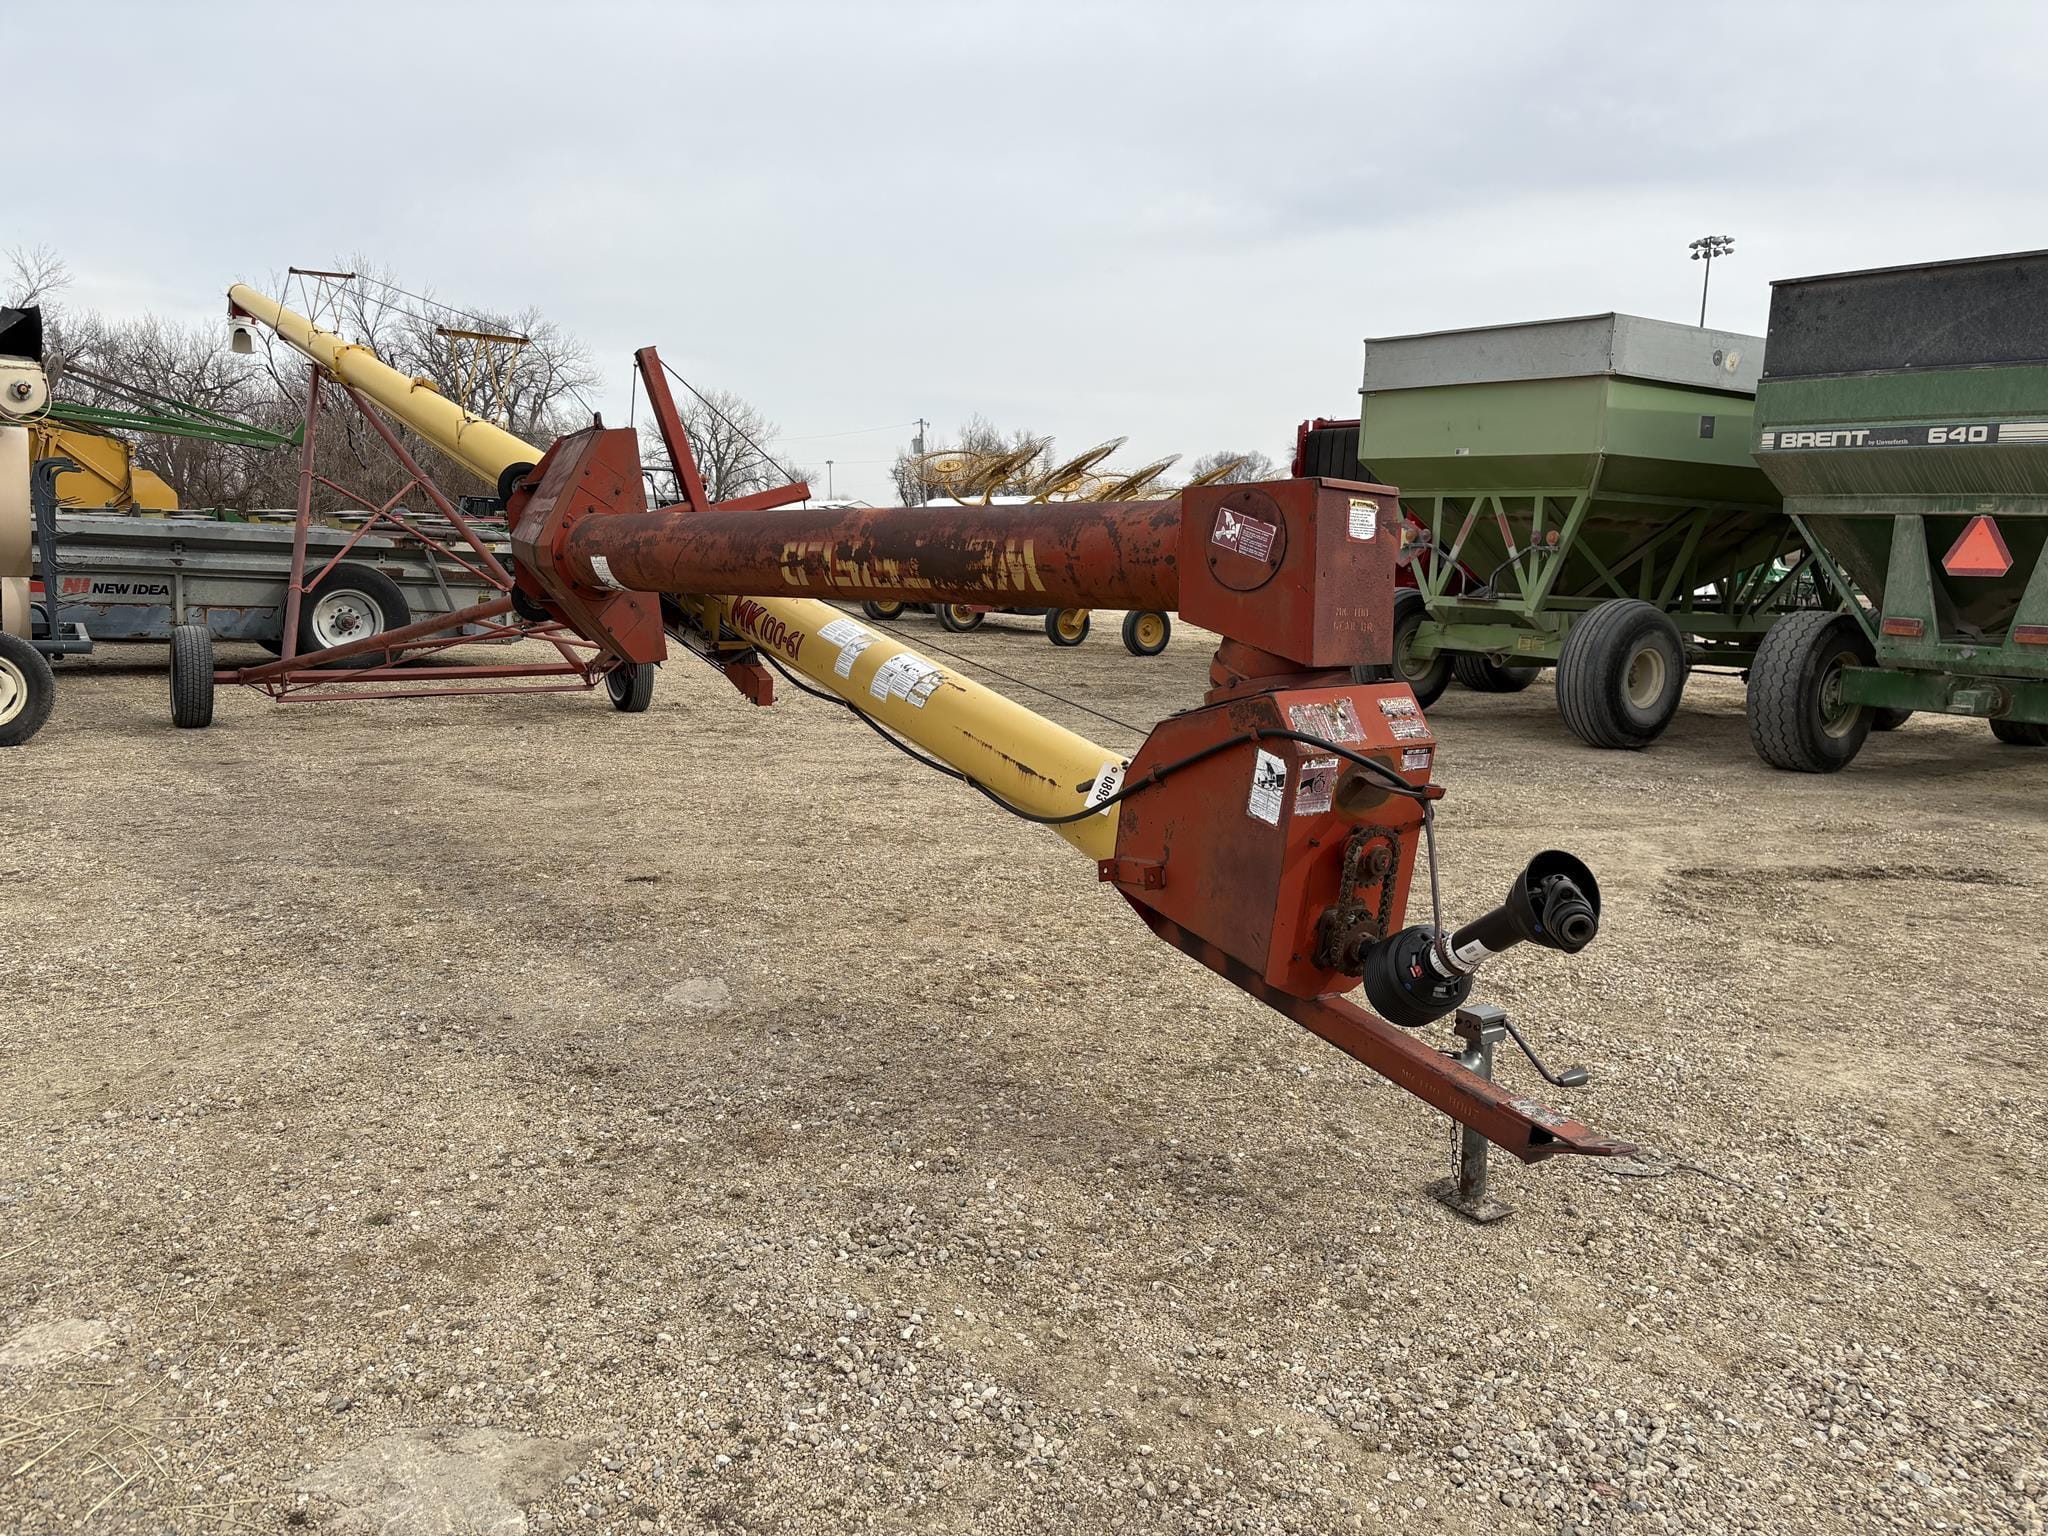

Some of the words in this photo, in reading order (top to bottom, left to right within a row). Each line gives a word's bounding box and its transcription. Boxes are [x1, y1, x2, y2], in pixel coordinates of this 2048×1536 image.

[1780, 430, 1870, 449] BRENT
[1927, 426, 1988, 444] 640
[92, 583, 131, 595] NEW
[132, 584, 170, 596] IDEA
[731, 595, 767, 641] MK
[760, 613, 805, 661] 100-61
[1095, 775, 1116, 803] 0893
